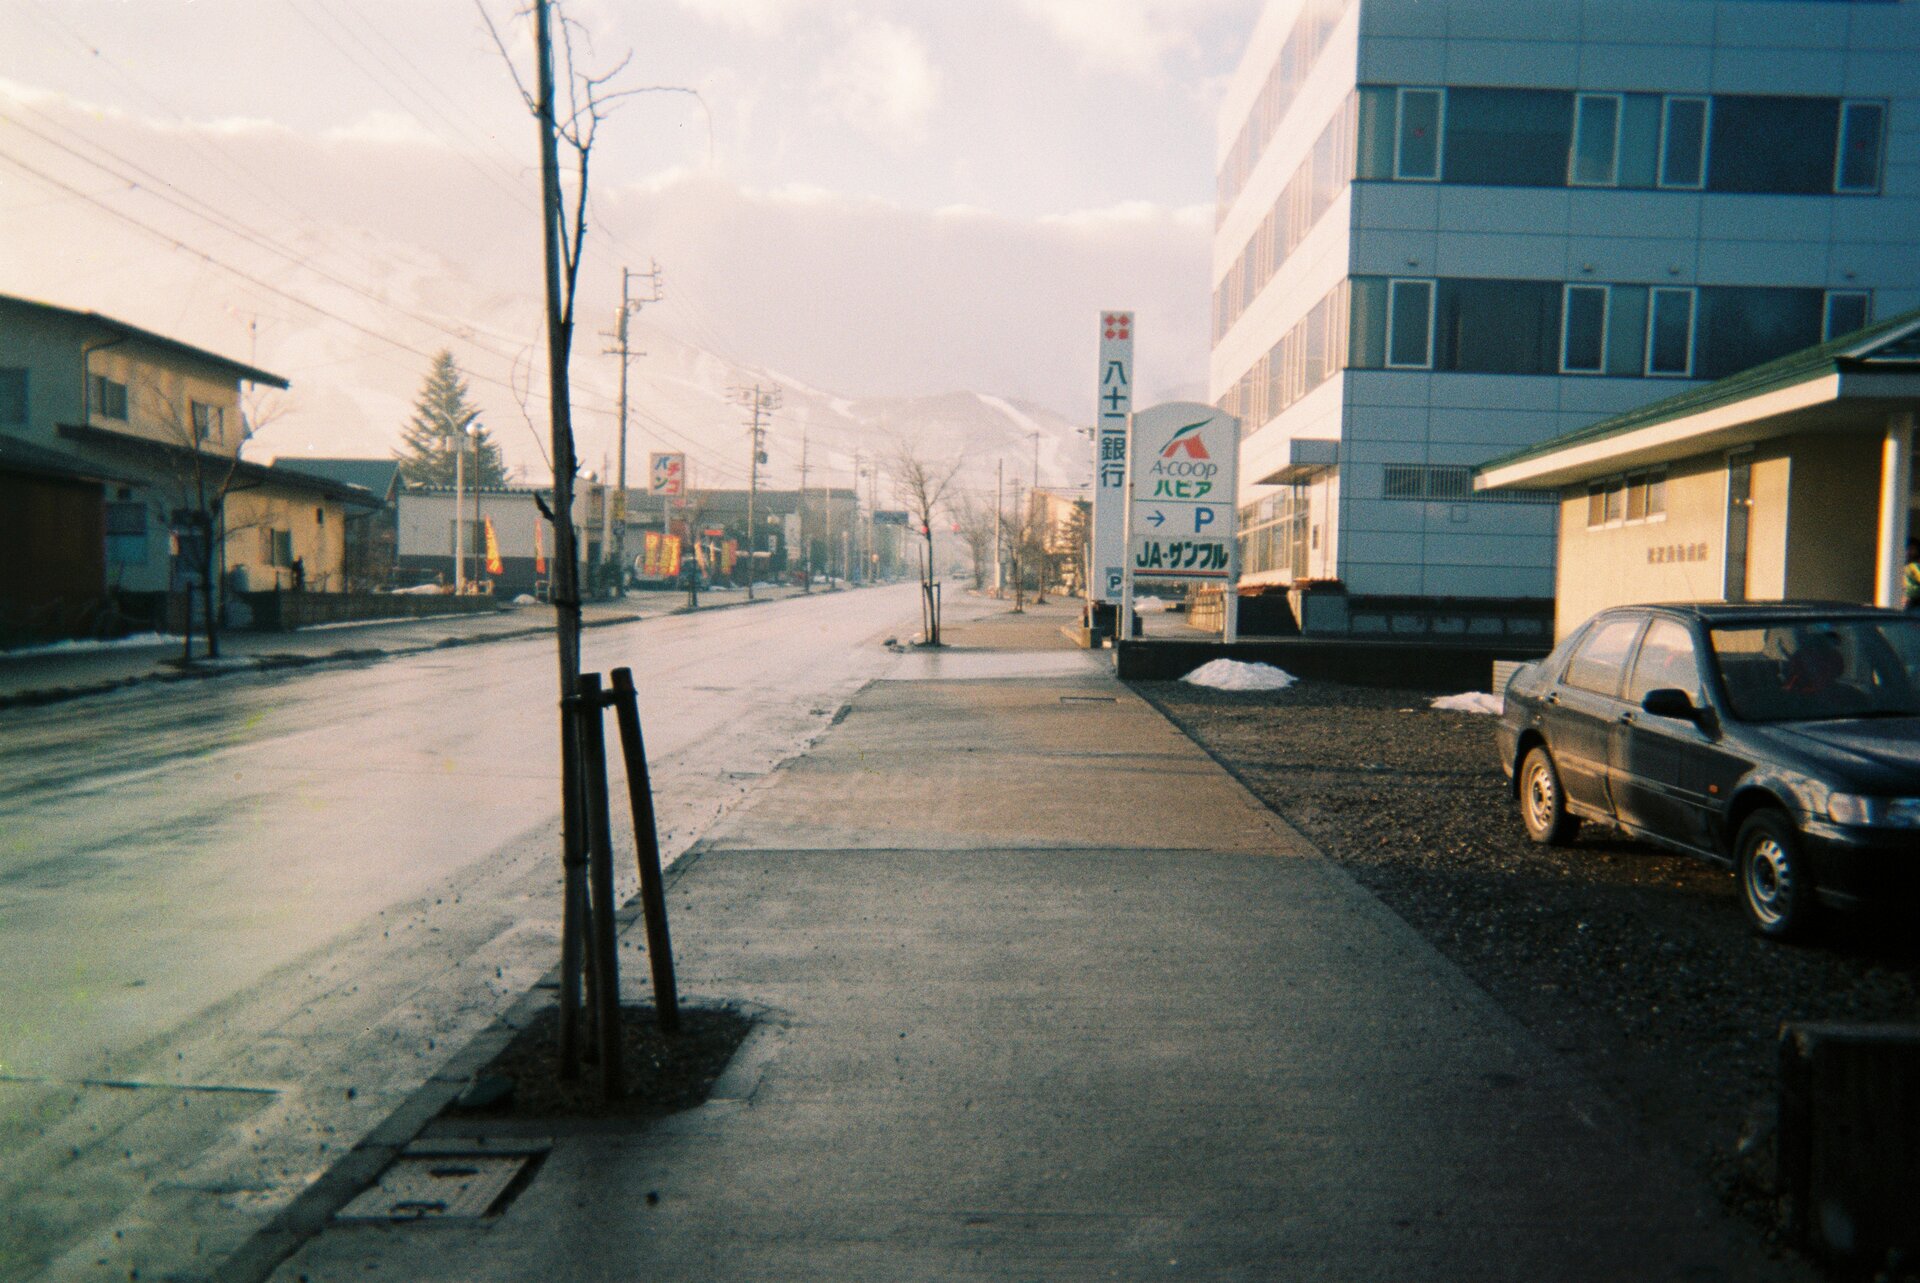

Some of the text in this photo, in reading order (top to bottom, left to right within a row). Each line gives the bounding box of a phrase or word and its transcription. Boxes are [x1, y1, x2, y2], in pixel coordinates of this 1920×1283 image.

[1100, 360, 1128, 488] 八十二銀行
[1194, 507, 1215, 533] P
[1110, 575, 1122, 589] P
